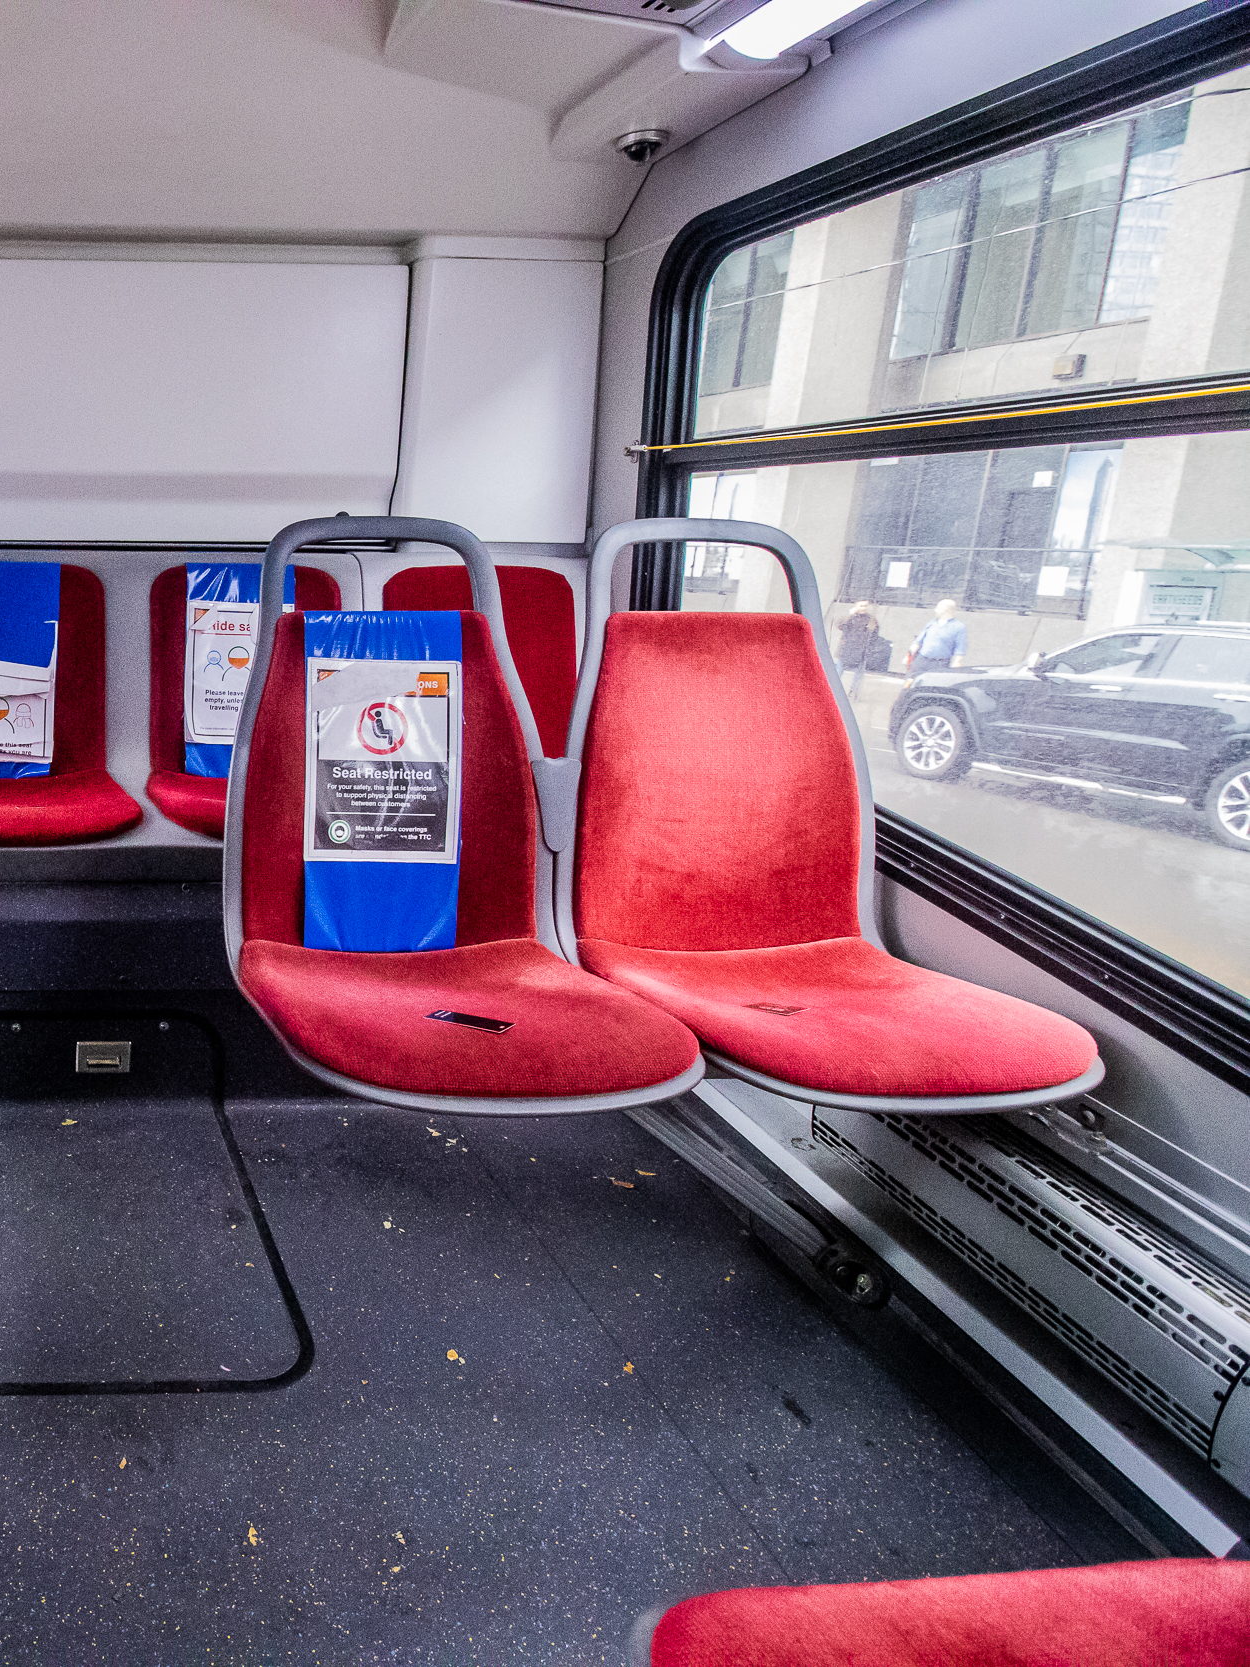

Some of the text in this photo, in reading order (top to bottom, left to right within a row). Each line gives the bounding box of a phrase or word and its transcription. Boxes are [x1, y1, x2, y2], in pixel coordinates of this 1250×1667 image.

[209, 704, 239, 712] travelling
[332, 766, 432, 780] Seat Restricted
[327, 782, 338, 790] For
[338, 784, 352, 792] your
[353, 783, 373, 792] safety,
[343, 791, 367, 799] support
[367, 792, 393, 800] physical
[394, 793, 427, 801] distancing
[378, 800, 411, 808] customers
[398, 826, 428, 834] coverings
